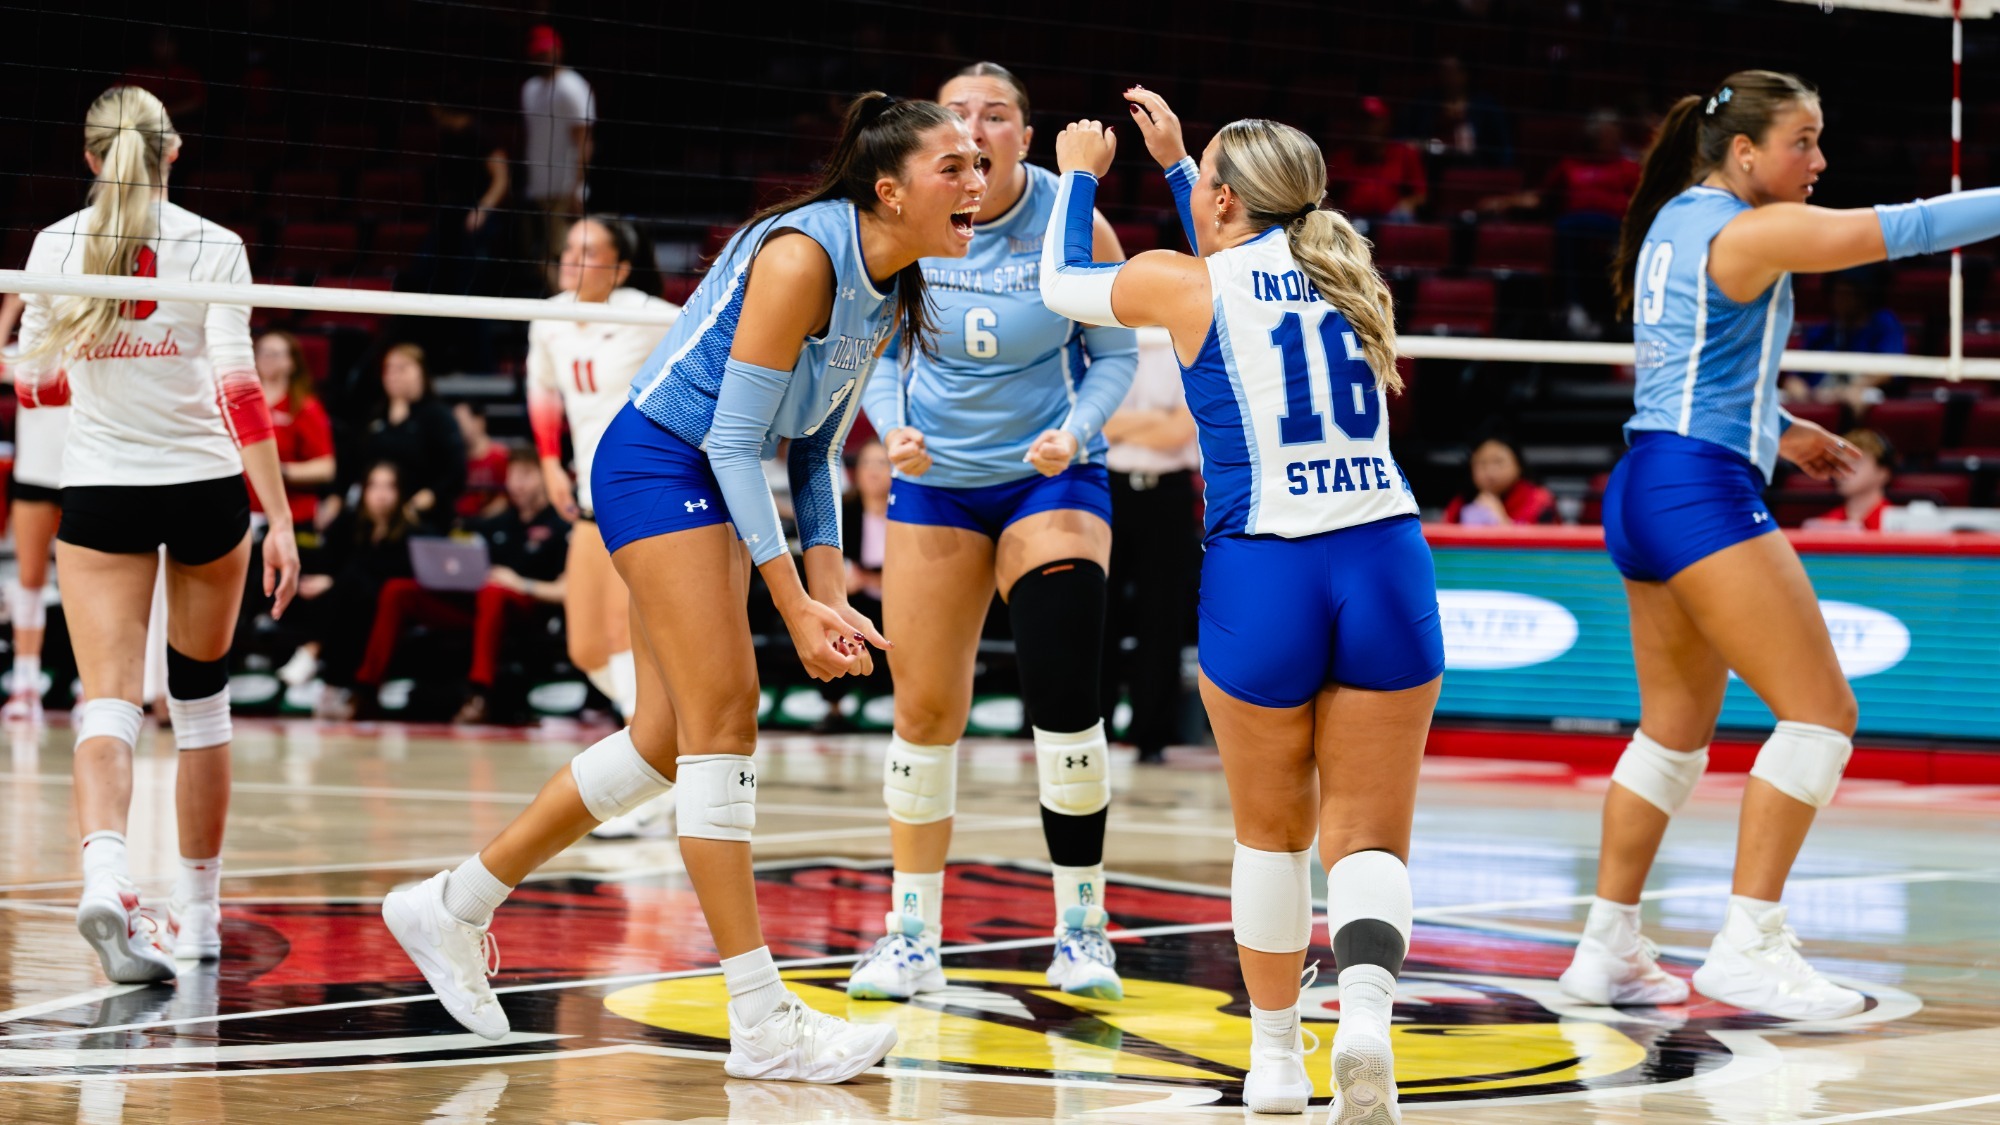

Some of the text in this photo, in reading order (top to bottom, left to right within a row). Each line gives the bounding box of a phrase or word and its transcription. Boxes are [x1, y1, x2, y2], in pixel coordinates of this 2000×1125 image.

[922, 261, 1042, 294] DIANA STAT
[1251, 269, 1326, 303] INDIA
[1633, 239, 1674, 326] 19
[963, 306, 998, 359] 6
[573, 359, 597, 394] 11
[1267, 310, 1381, 447] 16
[1286, 456, 1391, 496] STATE
